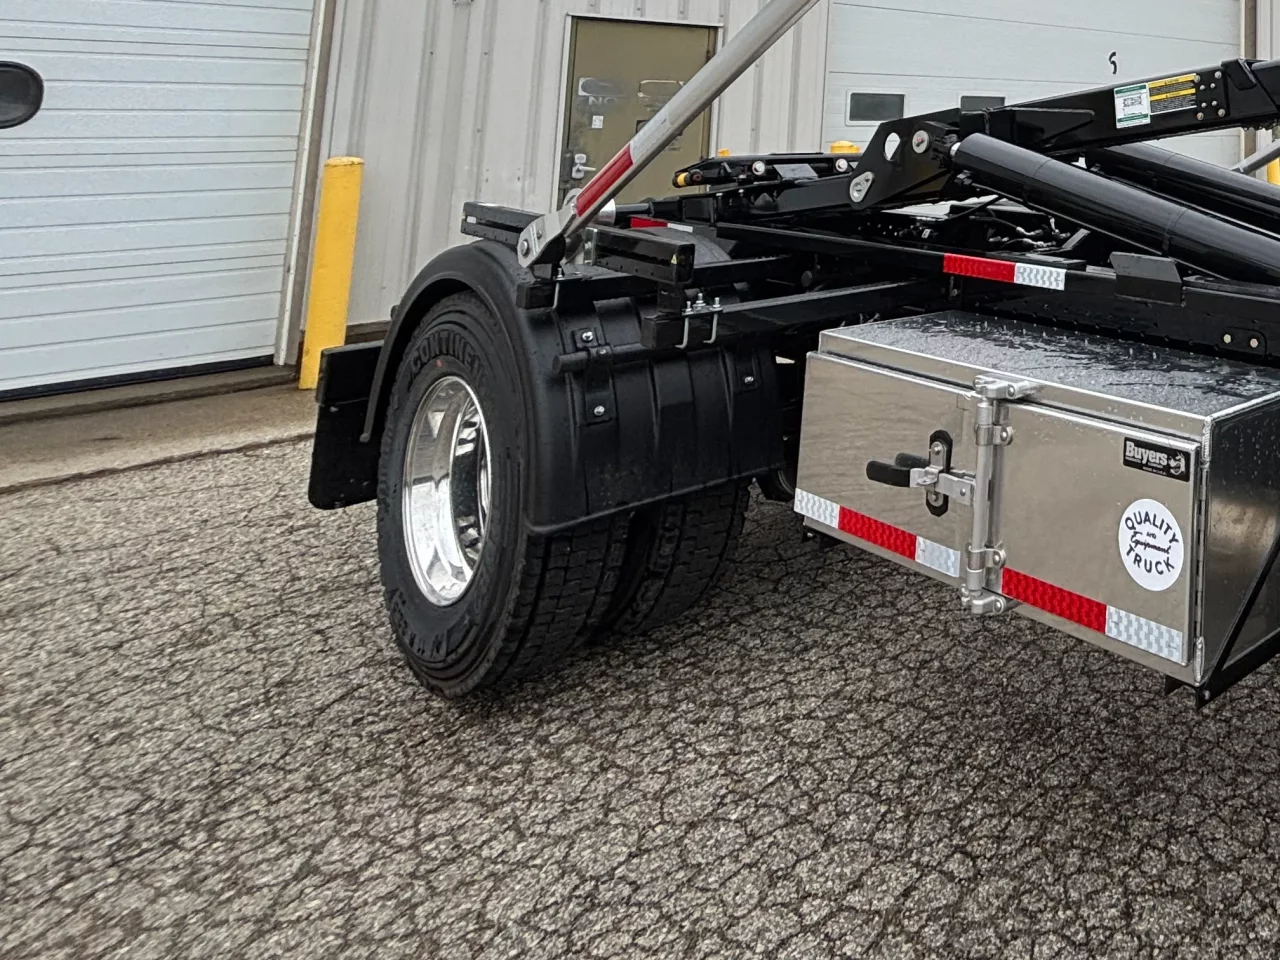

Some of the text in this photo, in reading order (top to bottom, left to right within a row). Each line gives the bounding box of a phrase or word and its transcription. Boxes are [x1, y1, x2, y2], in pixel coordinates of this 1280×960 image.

[1125, 440, 1168, 465] Buyers
[1125, 511, 1179, 544] QUALITY
[1130, 531, 1172, 554] Equipment
[1126, 543, 1175, 575] TRUCK
